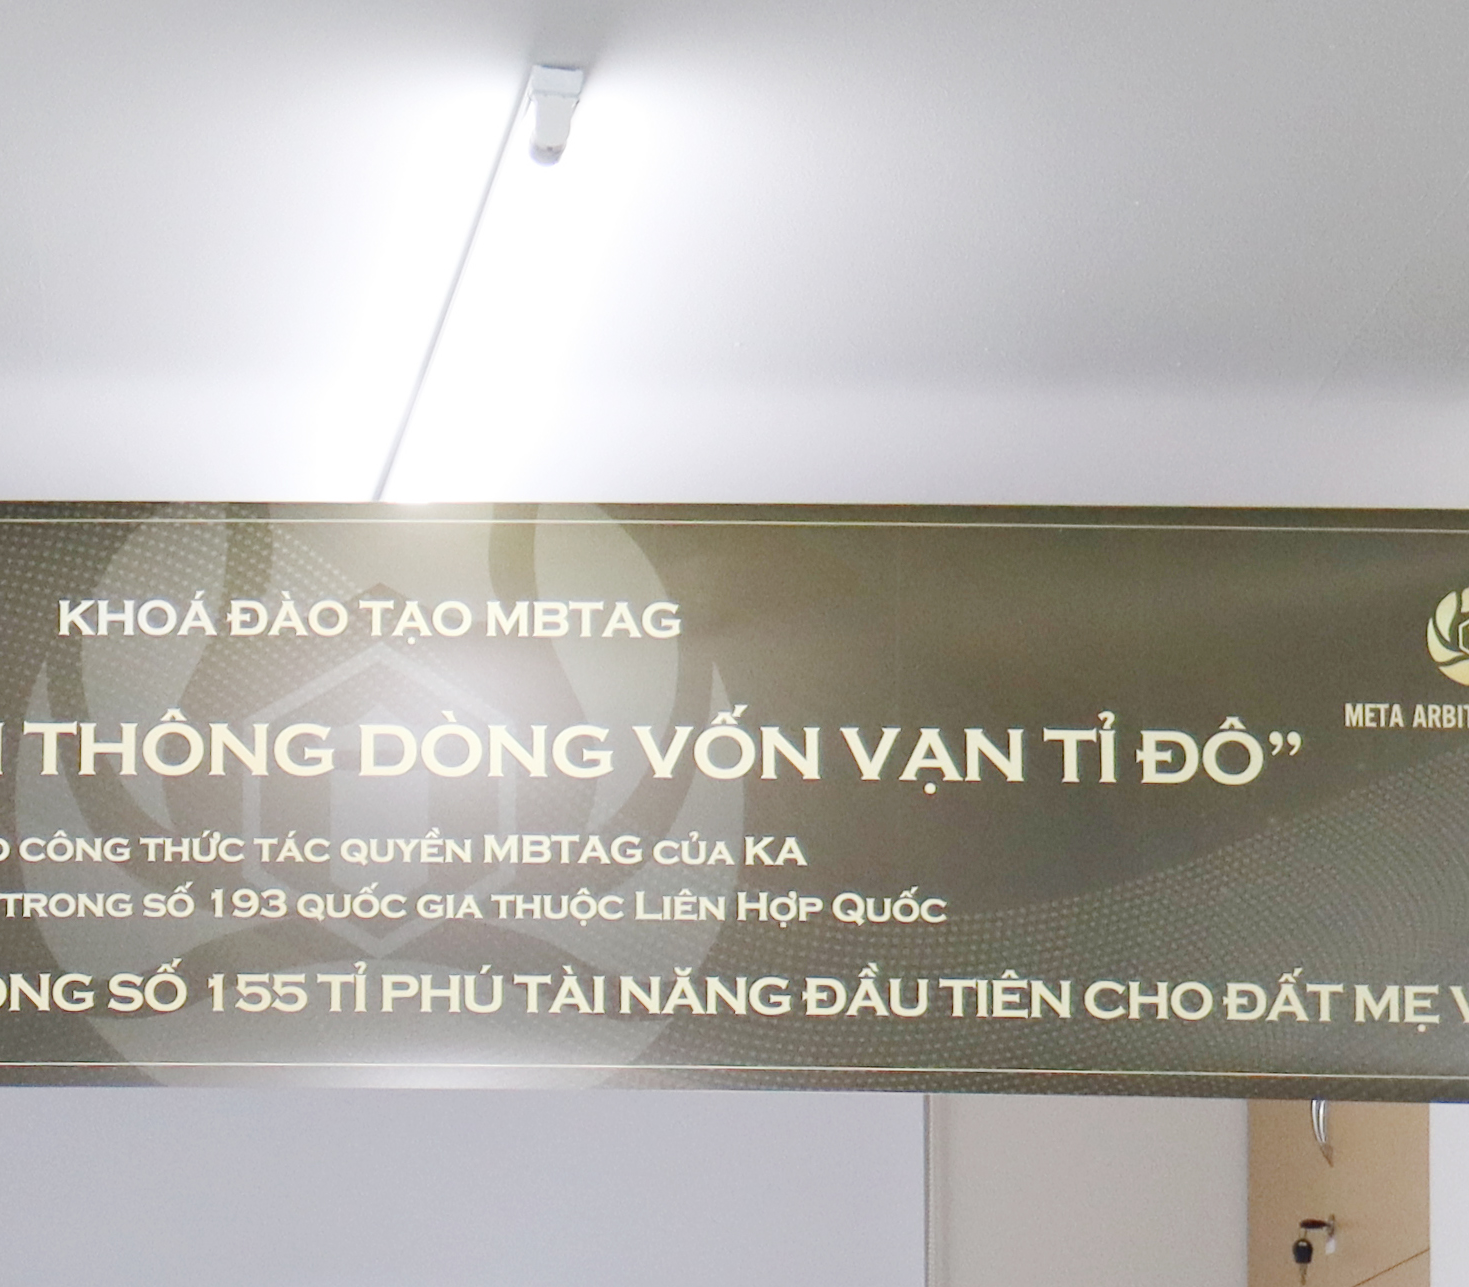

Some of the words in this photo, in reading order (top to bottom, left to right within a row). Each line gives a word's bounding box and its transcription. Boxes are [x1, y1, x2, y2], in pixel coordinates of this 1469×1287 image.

[58, 590, 218, 637] KHOÁ
[226, 590, 348, 637] ĐÀO
[359, 599, 473, 645] TẠO
[486, 600, 682, 639] MBTAG
[1344, 702, 1406, 729] META
[22, 707, 336, 777] THÔNG
[358, 710, 614, 779] DÒNG
[632, 704, 822, 780] VỐN
[839, 727, 1025, 794] VẠN
[1043, 712, 1118, 783] TỈ
[19, 830, 131, 863] CÔNG
[139, 830, 246, 863] THỨC
[253, 830, 333, 863] TÁC
[340, 828, 472, 865] QUYỀN
[482, 834, 644, 864] MBTAG
[652, 832, 736, 865] CỦA
[744, 835, 808, 866] KA
[143, 883, 196, 918] SỐ
[210, 887, 288, 918] 193
[296, 883, 407, 921] QUỐC
[416, 893, 483, 919] GIA
[491, 893, 625, 926] THUỘC
[107, 959, 189, 1012] SỐ
[207, 973, 308, 1012] 155
[316, 961, 368, 1012] TỈ
[381, 963, 504, 1013] PHÚ
[513, 966, 606, 1014] TÀI
[618, 966, 793, 1016] NĂNG
[801, 962, 929, 1018] ĐẦU
[938, 970, 1072, 1020] TIÊN
[1083, 979, 1214, 1021] CHO
[1222, 968, 1345, 1024] ĐẤT
[1354, 984, 1440, 1034] MẸ
